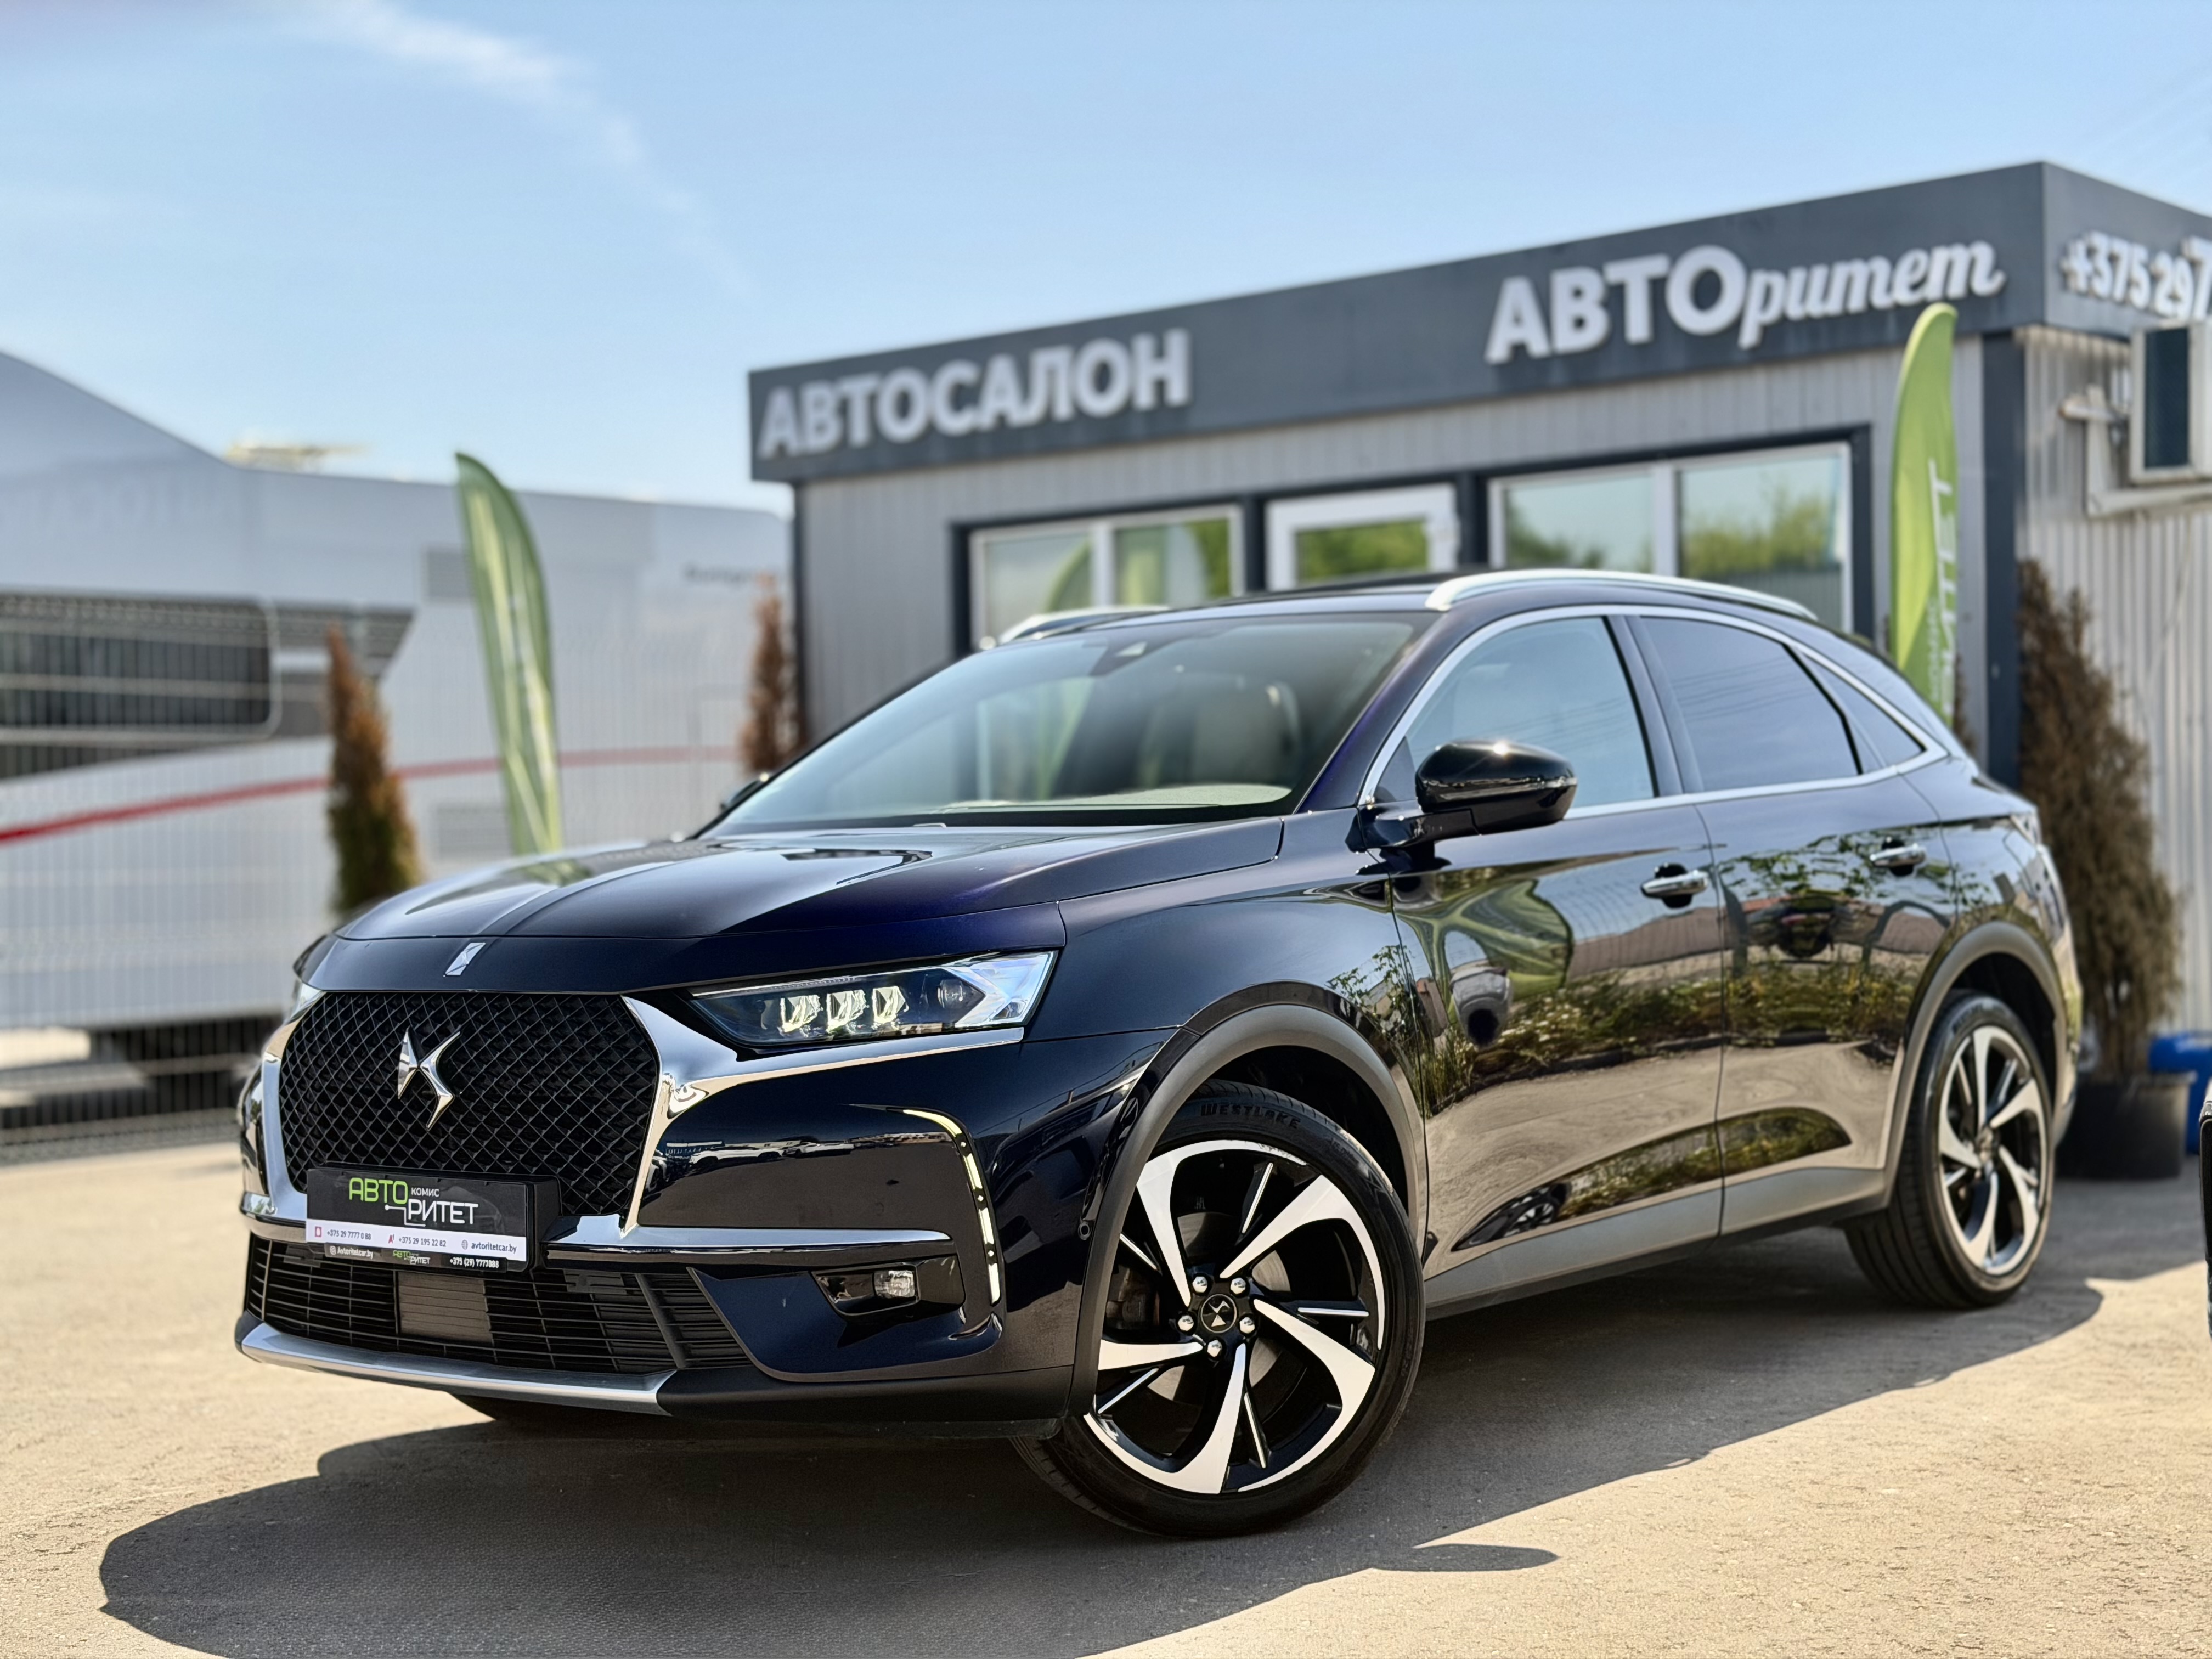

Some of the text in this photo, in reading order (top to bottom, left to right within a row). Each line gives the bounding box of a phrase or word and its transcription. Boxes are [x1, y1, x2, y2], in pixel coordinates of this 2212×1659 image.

[2059, 230, 2151, 309] +375
[2150, 251, 2194, 320] 29
[758, 329, 1192, 459] АВТОСАЛОН
[1200, 1104, 1301, 1128] WESTLAKE
[349, 1177, 408, 1204] АВТО
[408, 1199, 479, 1225] РИТЕТ
[327, 1229, 340, 1238] +375
[341, 1230, 347, 1238] 29
[399, 1236, 411, 1245] +375
[421, 1238, 431, 1246] 195
[439, 1239, 447, 1248] 82
[471, 1242, 517, 1254] avtoritetcar.by
[449, 1257, 463, 1266] +375
[464, 1257, 475, 1268] (29)
